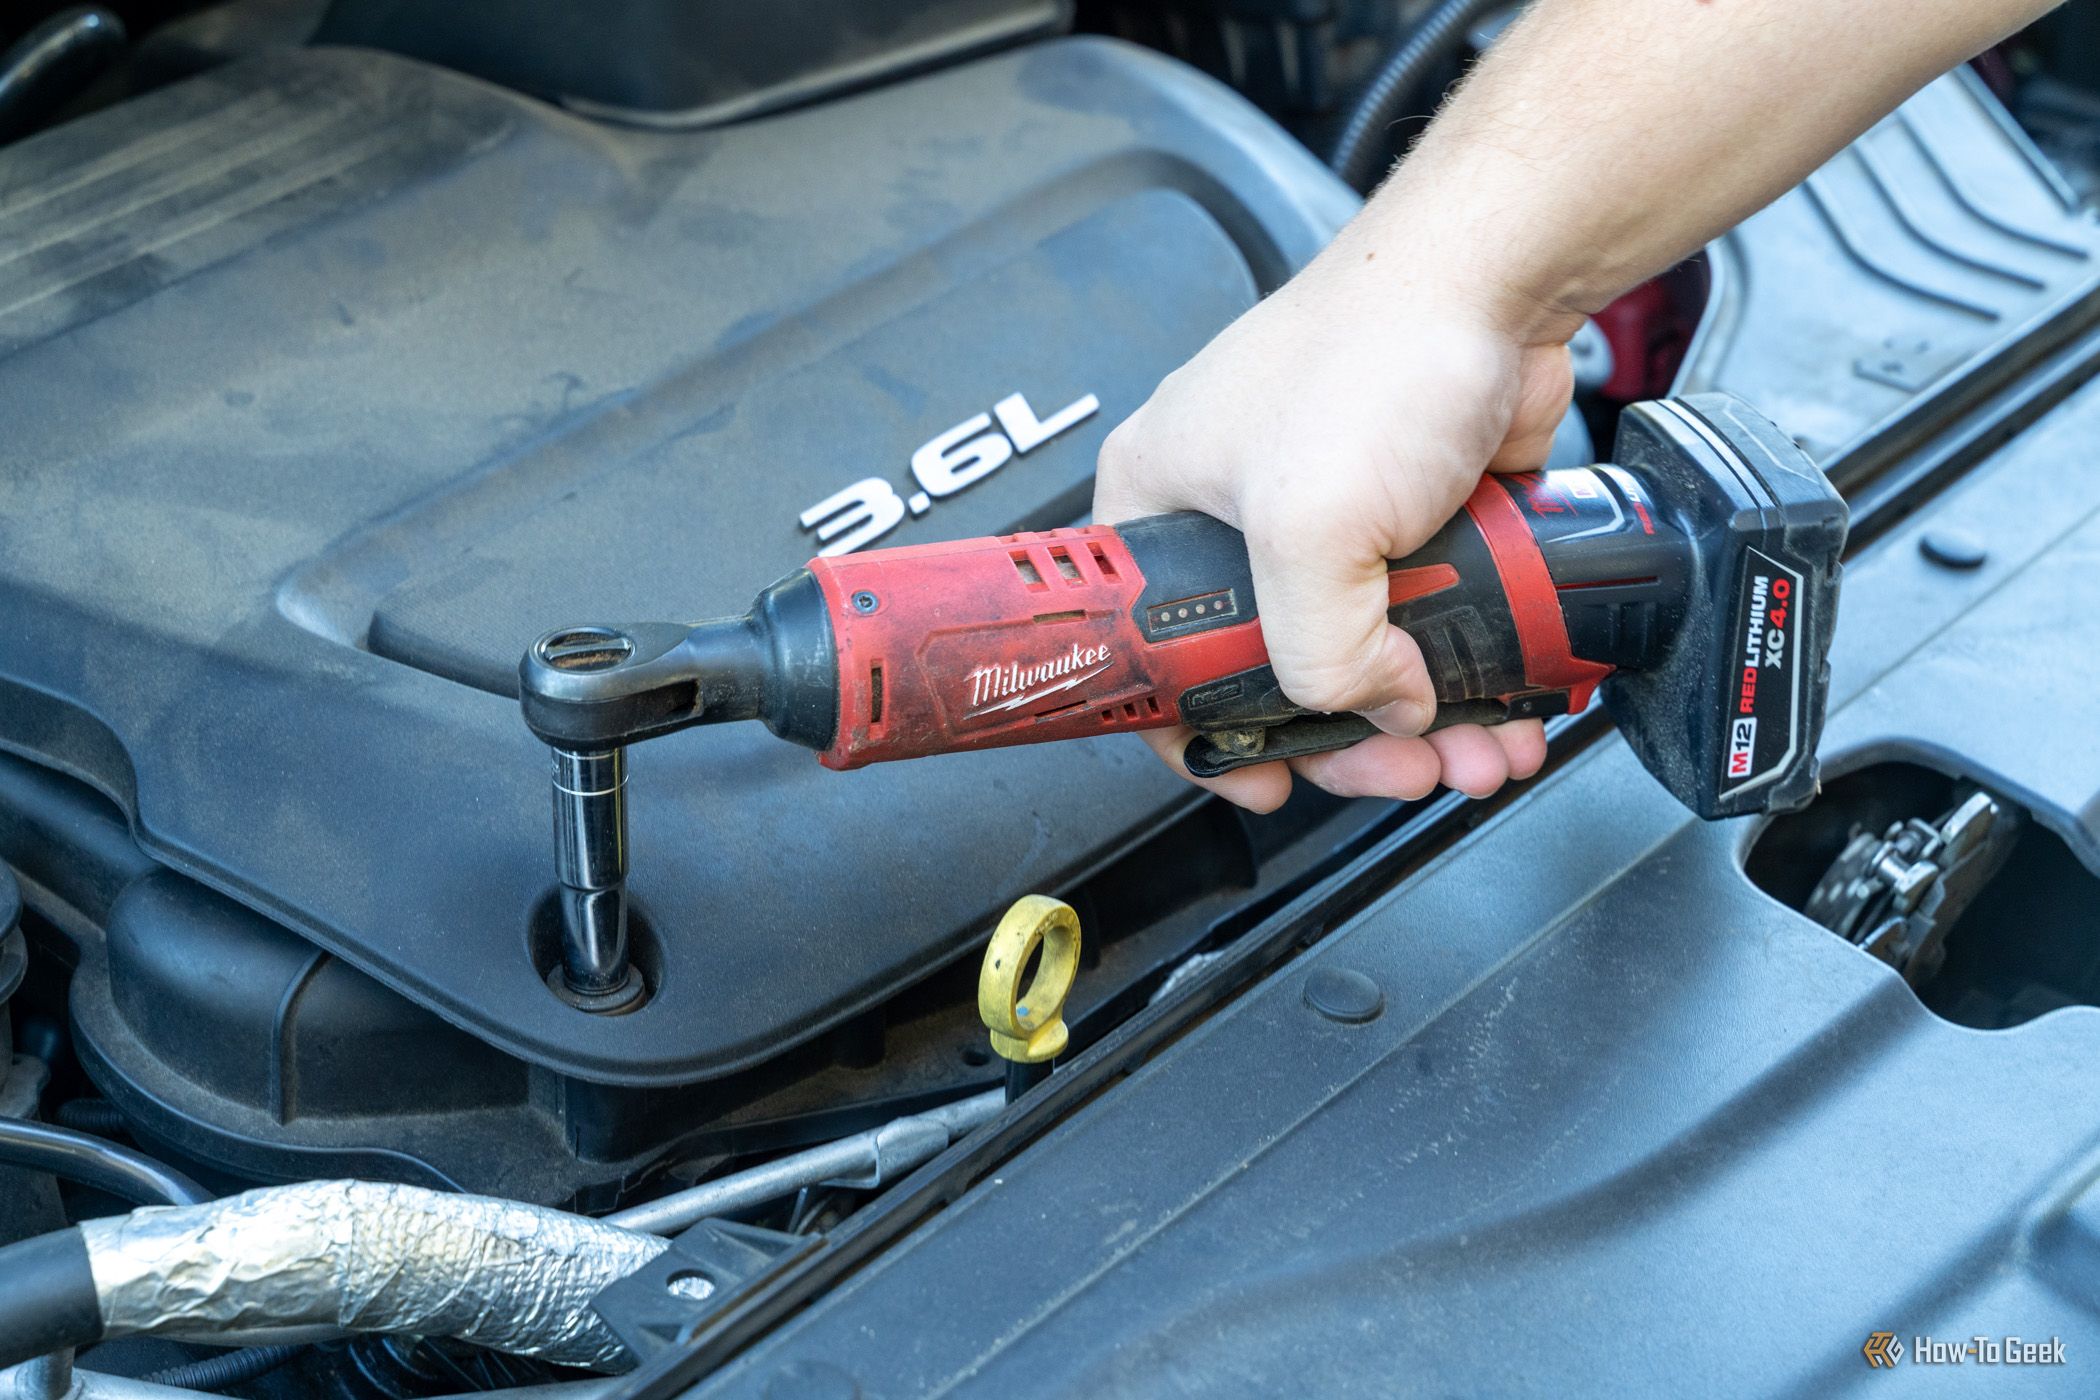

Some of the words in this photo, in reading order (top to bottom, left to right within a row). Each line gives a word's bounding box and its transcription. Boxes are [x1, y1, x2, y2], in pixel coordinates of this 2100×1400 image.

[800, 391, 1100, 558] 3.6L
[1739, 575, 1770, 714] REDLITHIUM
[1764, 578, 1791, 670] XC4.0
[964, 642, 1112, 707] Milwaukee
[1731, 722, 1753, 775] M12
